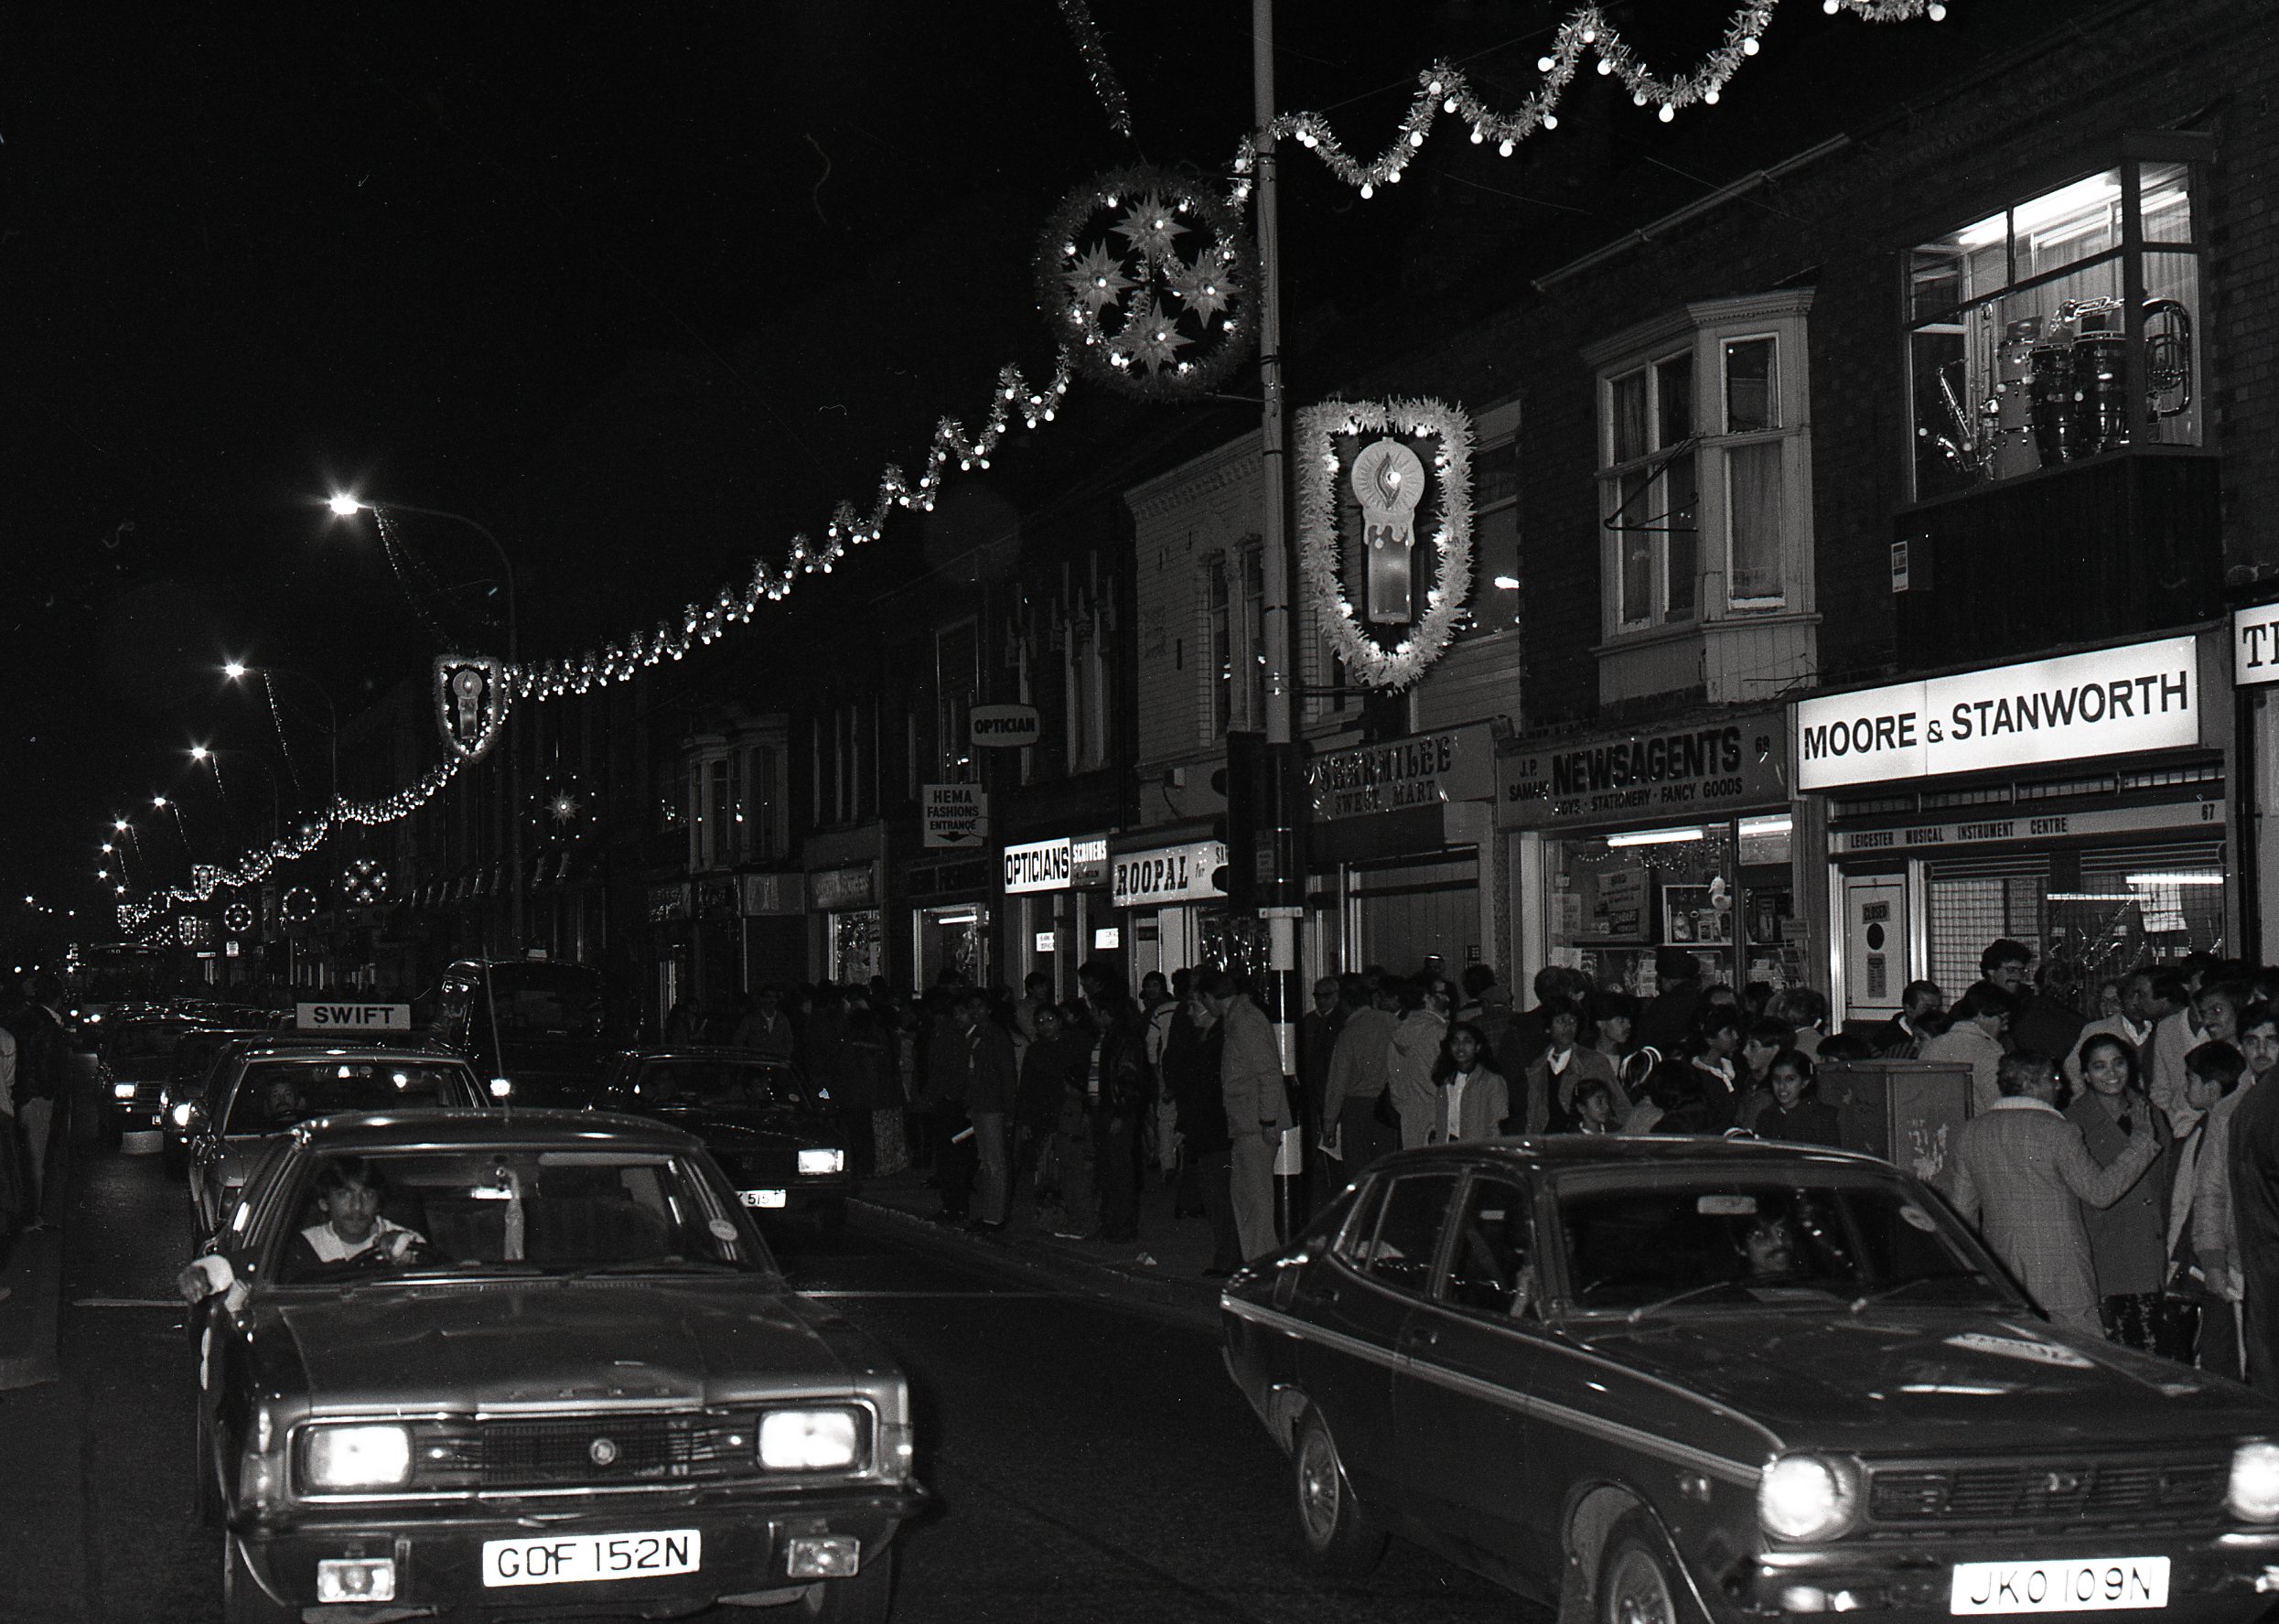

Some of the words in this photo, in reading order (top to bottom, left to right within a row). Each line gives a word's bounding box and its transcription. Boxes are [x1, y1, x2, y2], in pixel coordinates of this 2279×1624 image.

[974, 717, 1036, 734] OPTICIAN
[1804, 712, 1918, 760] MOORE
[1928, 720, 1944, 743] &
[1952, 671, 2188, 740] STANWORTH
[1553, 726, 1741, 796] NEWSAGENTS
[933, 790, 973, 803] HEMA
[1392, 780, 1435, 806] MART
[1592, 789, 1652, 812] STATIONERY
[1661, 781, 1696, 803] FANCY
[1703, 777, 1743, 799] GOODS
[927, 806, 979, 818] FASHIONS
[930, 821, 976, 831] ENTRANCE
[2201, 803, 2216, 821] 67
[1850, 832, 1895, 848] LEICESTER
[1906, 827, 1944, 844] MUSICAL
[1957, 821, 2014, 839] INSTRUMENT
[2030, 817, 2068, 834] CENTRE
[1005, 846, 1070, 885] OPTICIANS
[1116, 855, 1188, 897] ROOPAL
[313, 1006, 394, 1024] SWIFT
[498, 1543, 577, 1578] GOF
[595, 1536, 688, 1572] 152N
[1970, 1570, 2048, 1606] JKO
[2065, 1567, 2152, 1603] 109N
